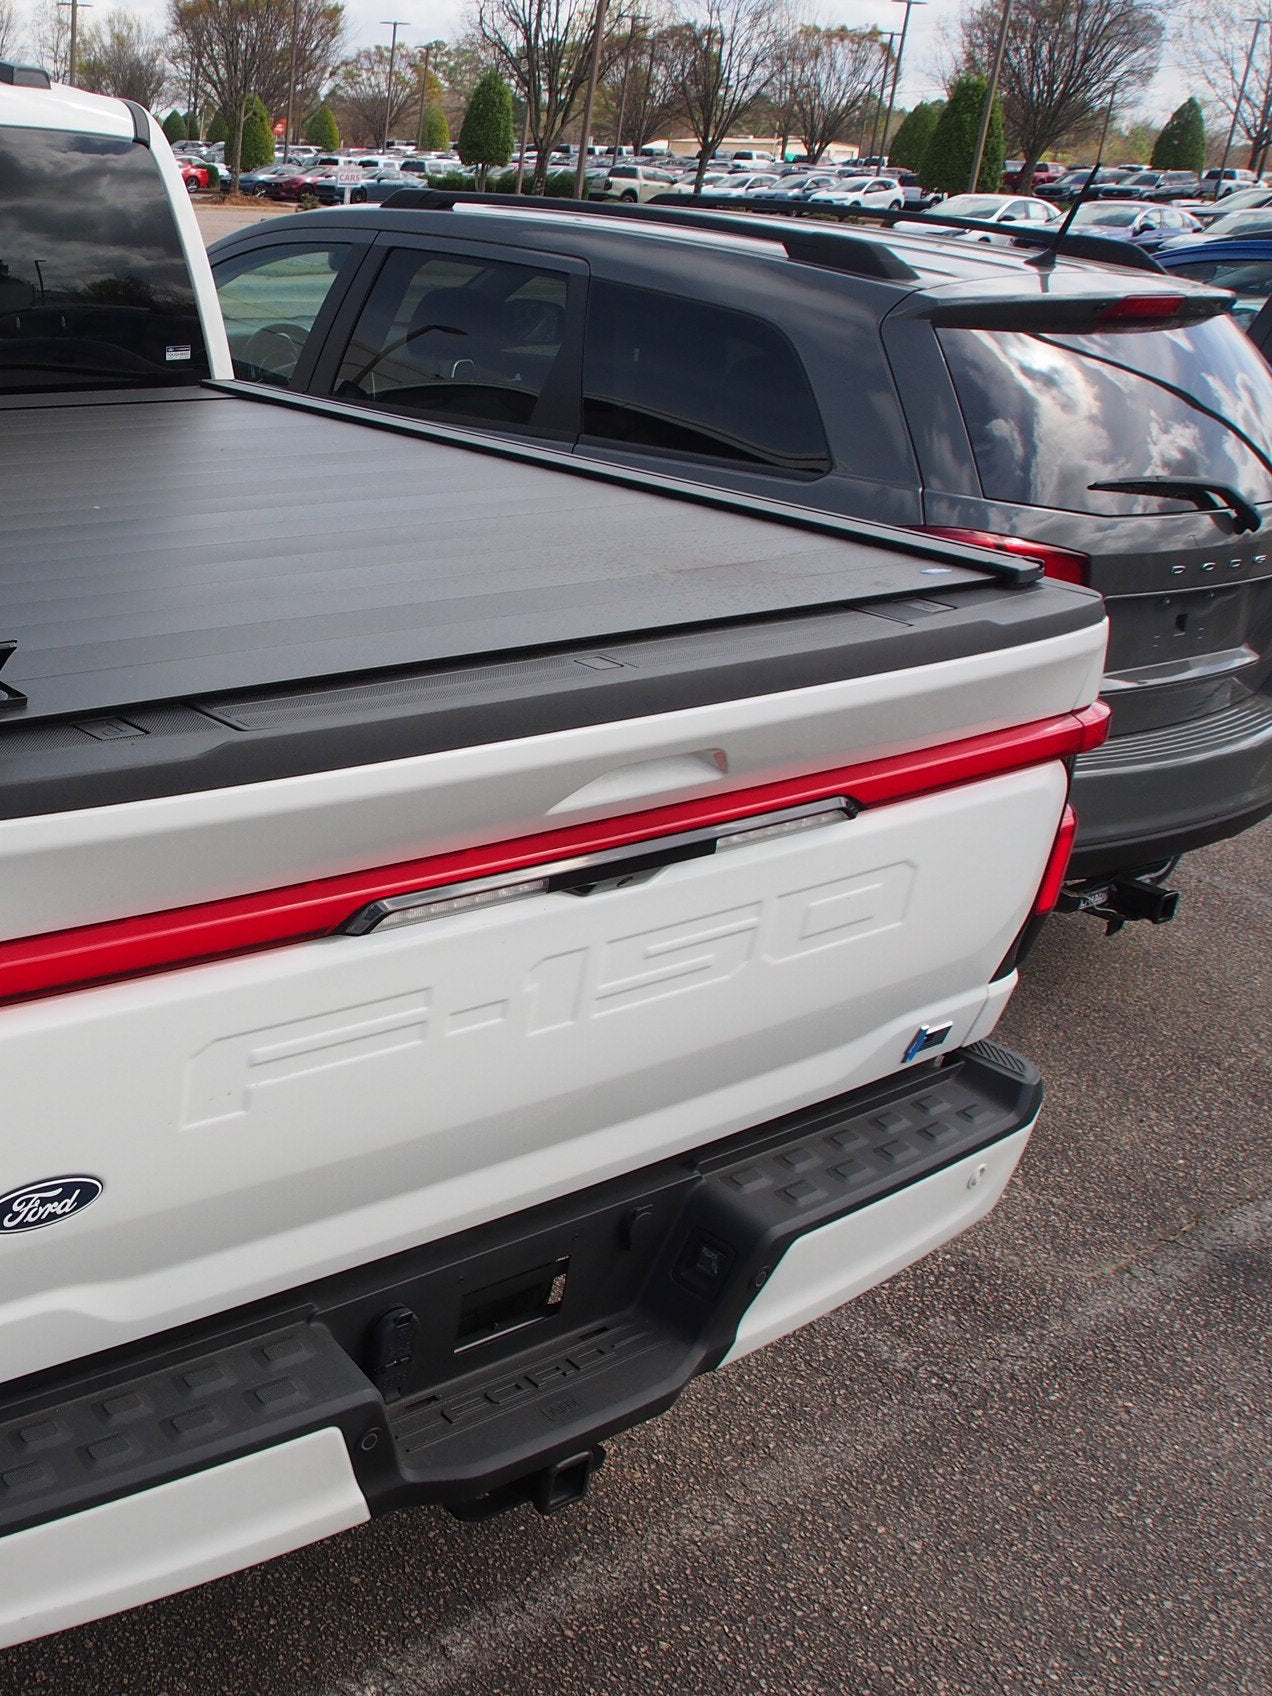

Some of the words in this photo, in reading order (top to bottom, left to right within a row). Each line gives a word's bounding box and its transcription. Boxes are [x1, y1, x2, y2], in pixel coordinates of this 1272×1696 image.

[178, 860, 916, 1132] F-150
[3, 1187, 81, 1228] Ford
[439, 1346, 613, 1424] FORD
